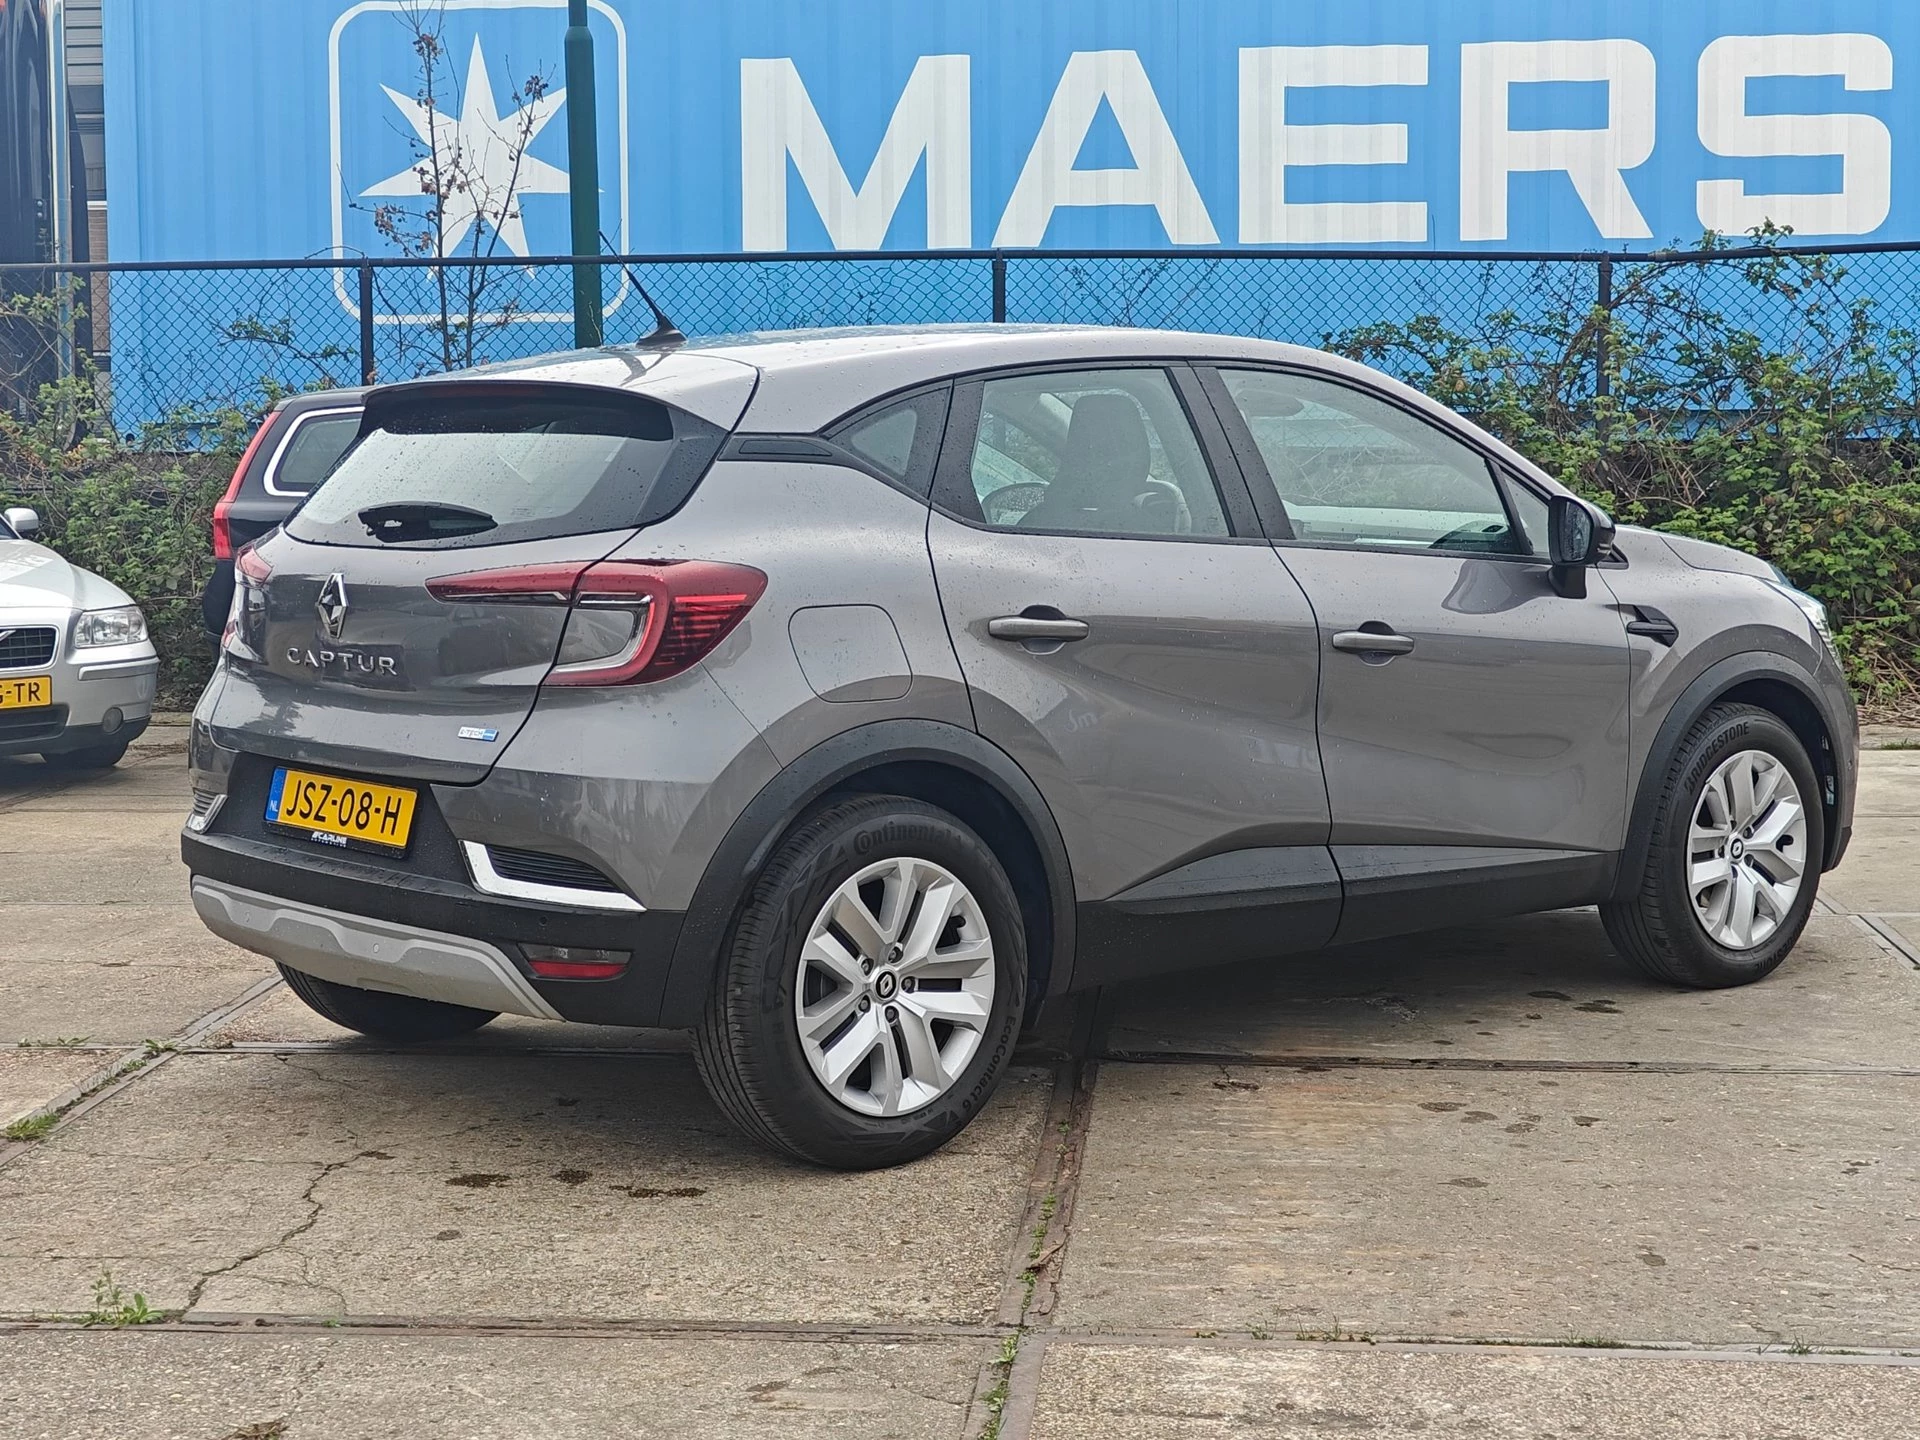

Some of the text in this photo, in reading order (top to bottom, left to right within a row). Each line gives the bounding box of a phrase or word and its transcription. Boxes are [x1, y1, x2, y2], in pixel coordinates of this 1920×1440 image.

[741, 33, 1893, 252] MAERS
[286, 646, 398, 676] CAPTUR
[0, 682, 41, 703] -TR
[1684, 721, 1750, 795] BRIDGESTONE
[269, 800, 278, 812] NL
[286, 780, 402, 836] JSZ-08-H
[853, 821, 952, 855] Continental
[962, 1015, 1017, 1112] EcoContact 6
